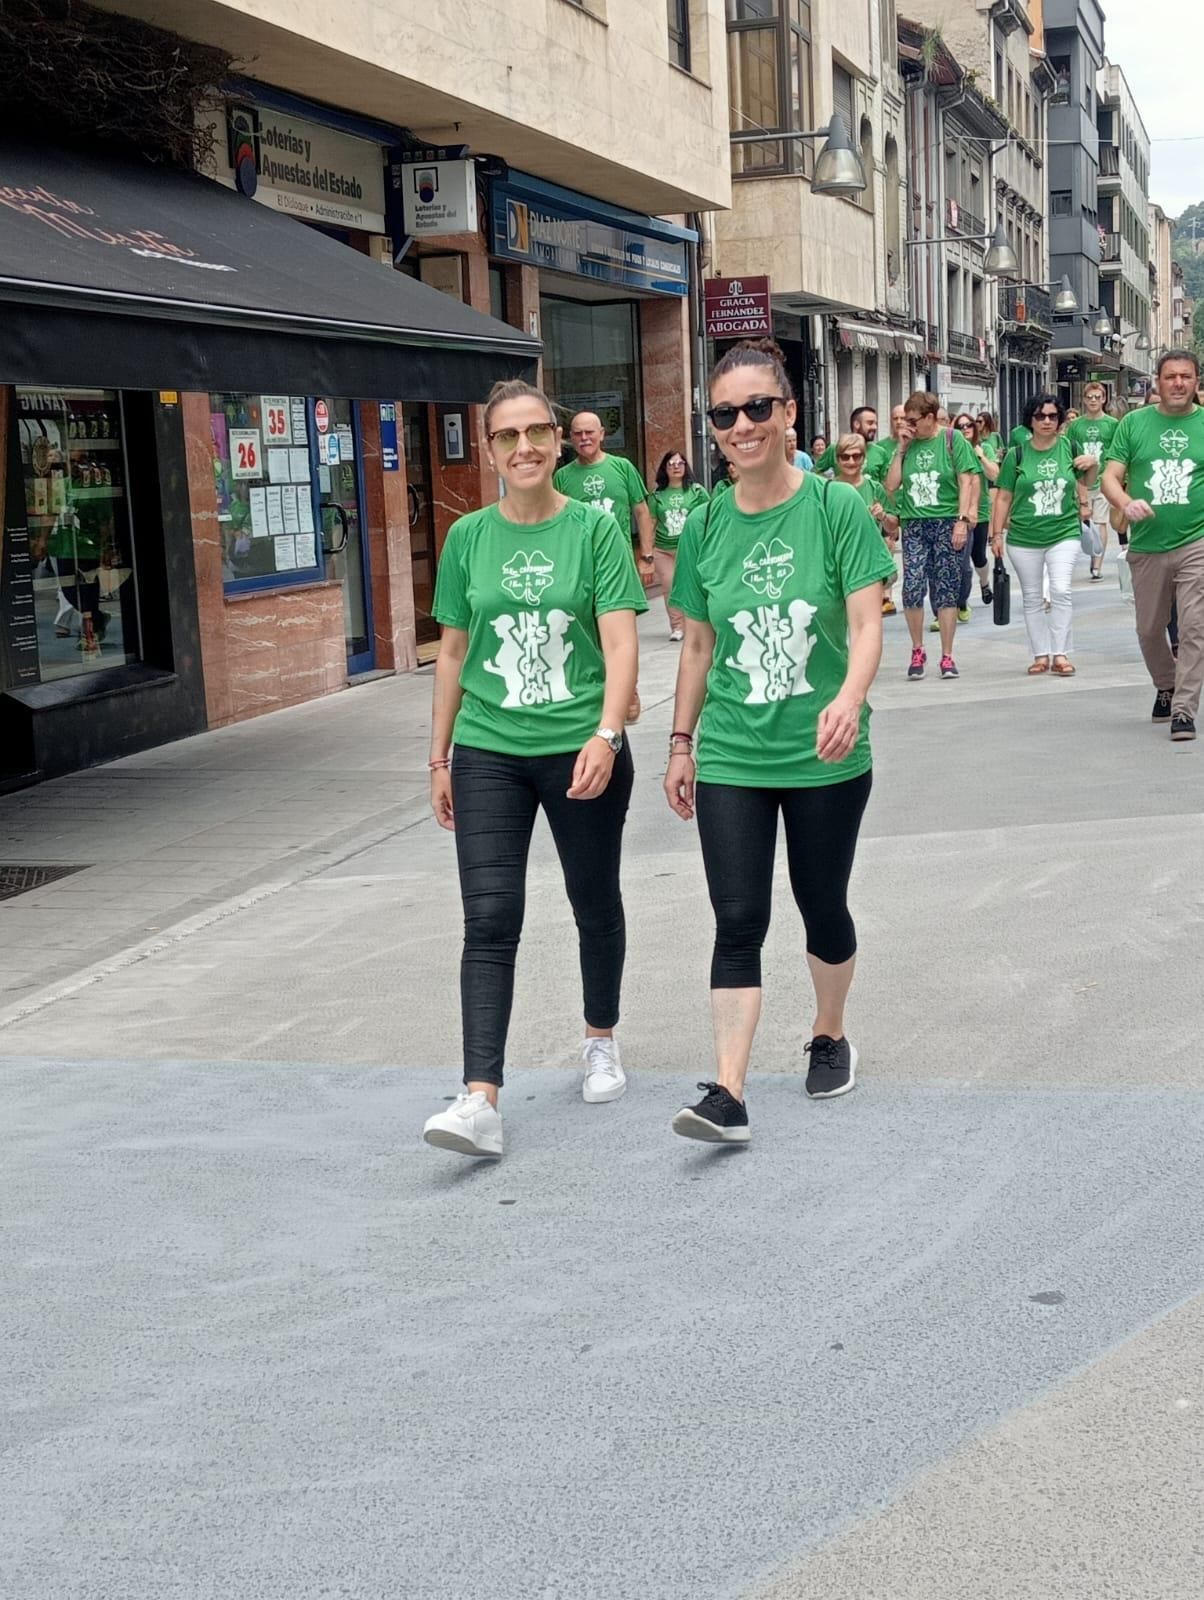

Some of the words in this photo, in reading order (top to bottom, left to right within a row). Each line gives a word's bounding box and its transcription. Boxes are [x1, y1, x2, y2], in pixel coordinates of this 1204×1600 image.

[260, 123, 303, 156] Loterías
[304, 140, 311, 163] y
[262, 154, 311, 187] Apuestas
[312, 166, 328, 192] del
[329, 172, 362, 200] Estado
[719, 297, 755, 307] GRACIA
[708, 320, 768, 333] ABOGADA
[268, 409, 285, 434] 35
[238, 442, 256, 469] 26
